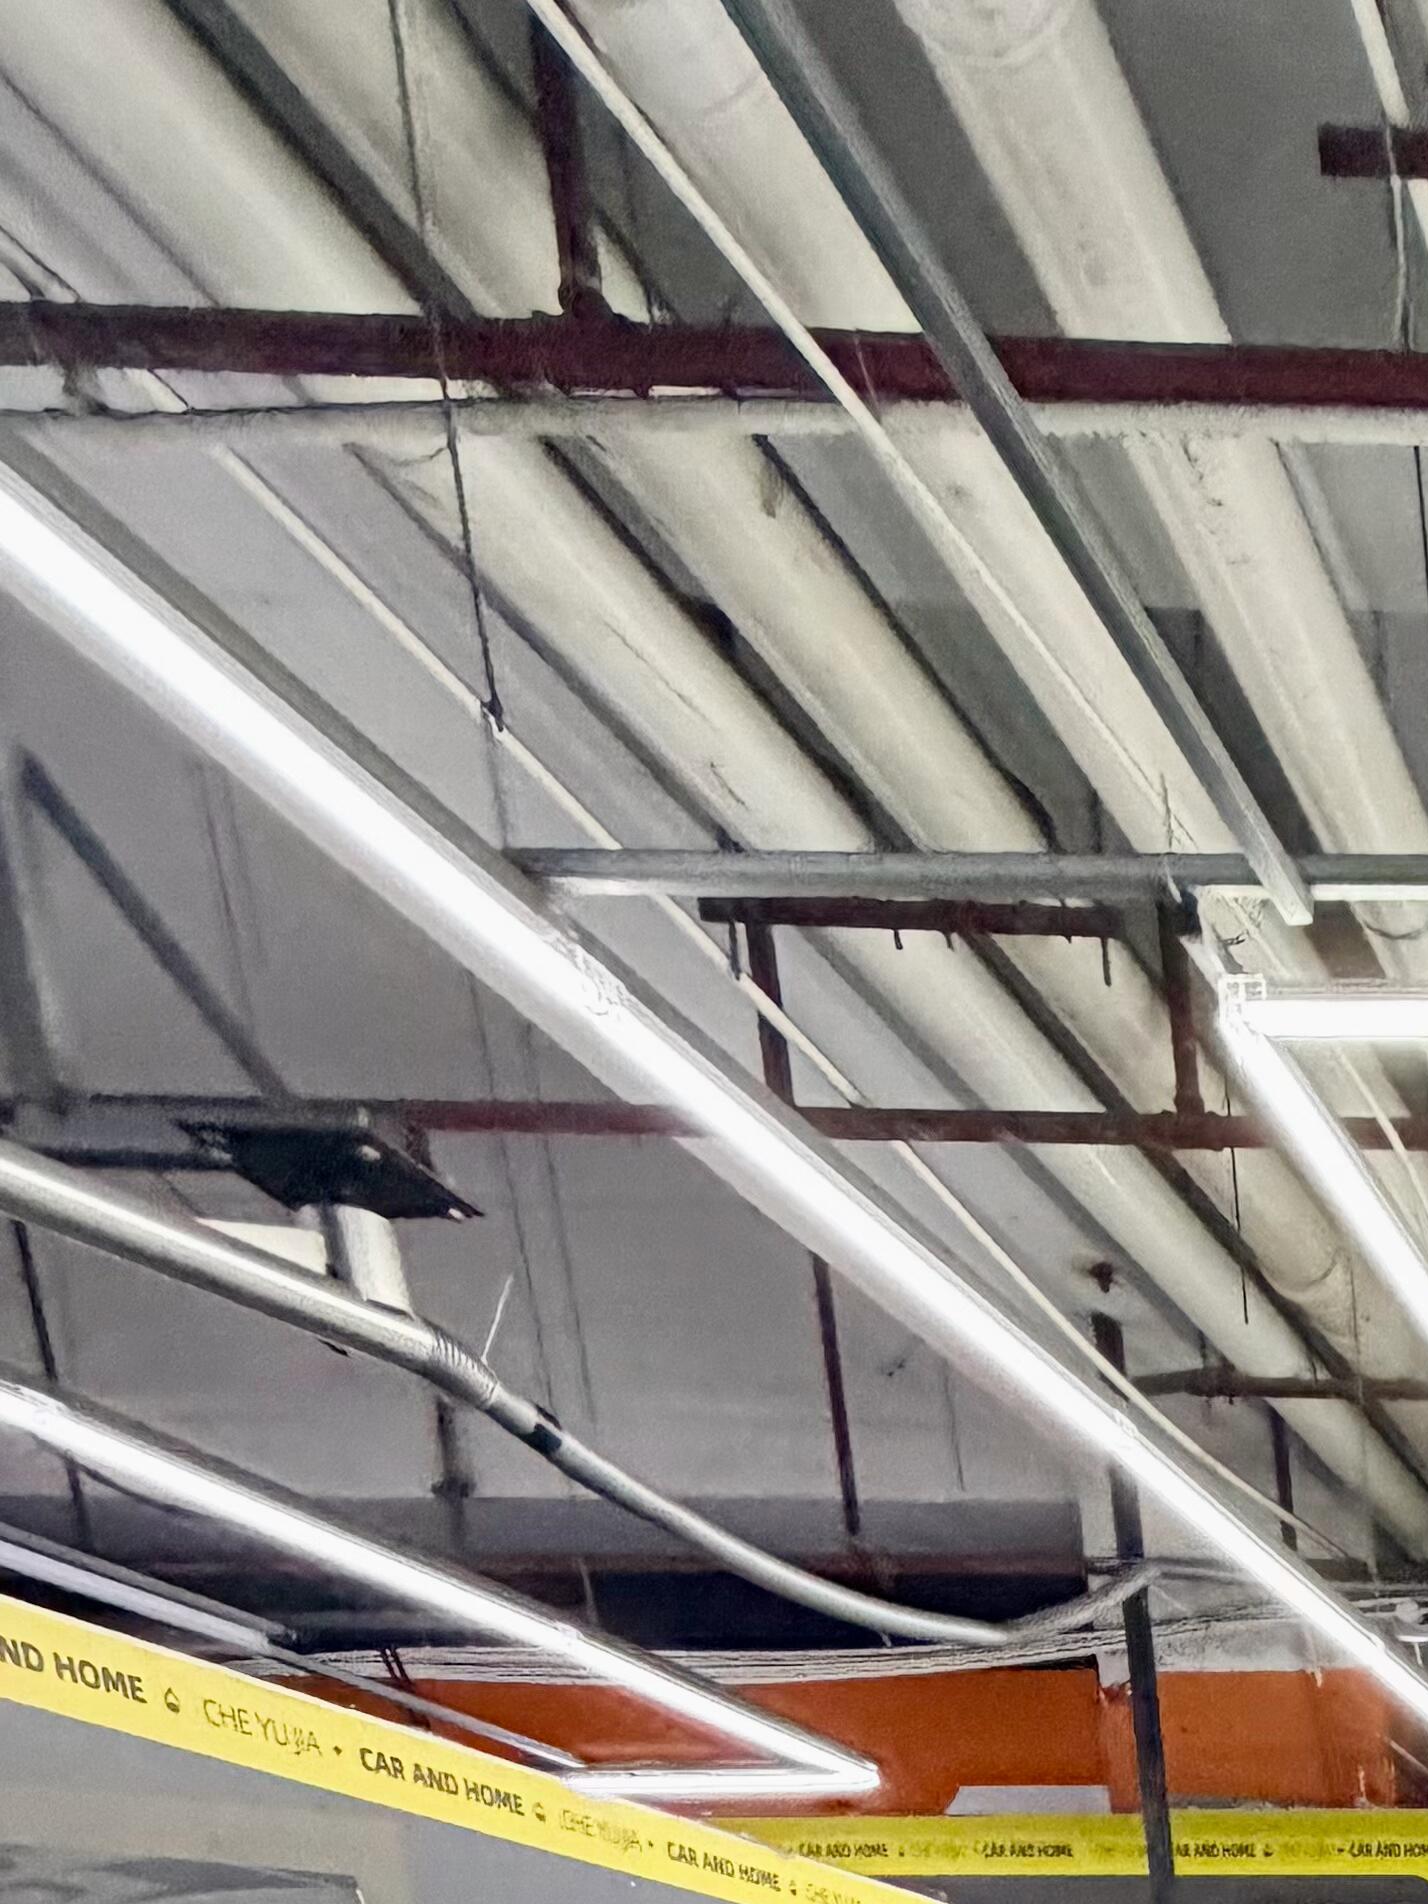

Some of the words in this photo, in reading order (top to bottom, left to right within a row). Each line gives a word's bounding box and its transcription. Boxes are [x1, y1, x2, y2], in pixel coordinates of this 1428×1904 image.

[52, 1651, 148, 1704] HOME
[203, 1699, 253, 1736] CHE
[359, 1747, 406, 1781] CAR
[413, 1763, 458, 1795] AND
[463, 1777, 525, 1816] HOME
[667, 1842, 699, 1868] CAR
[703, 1853, 734, 1878] AND
[1376, 1843, 1401, 1857] AND
